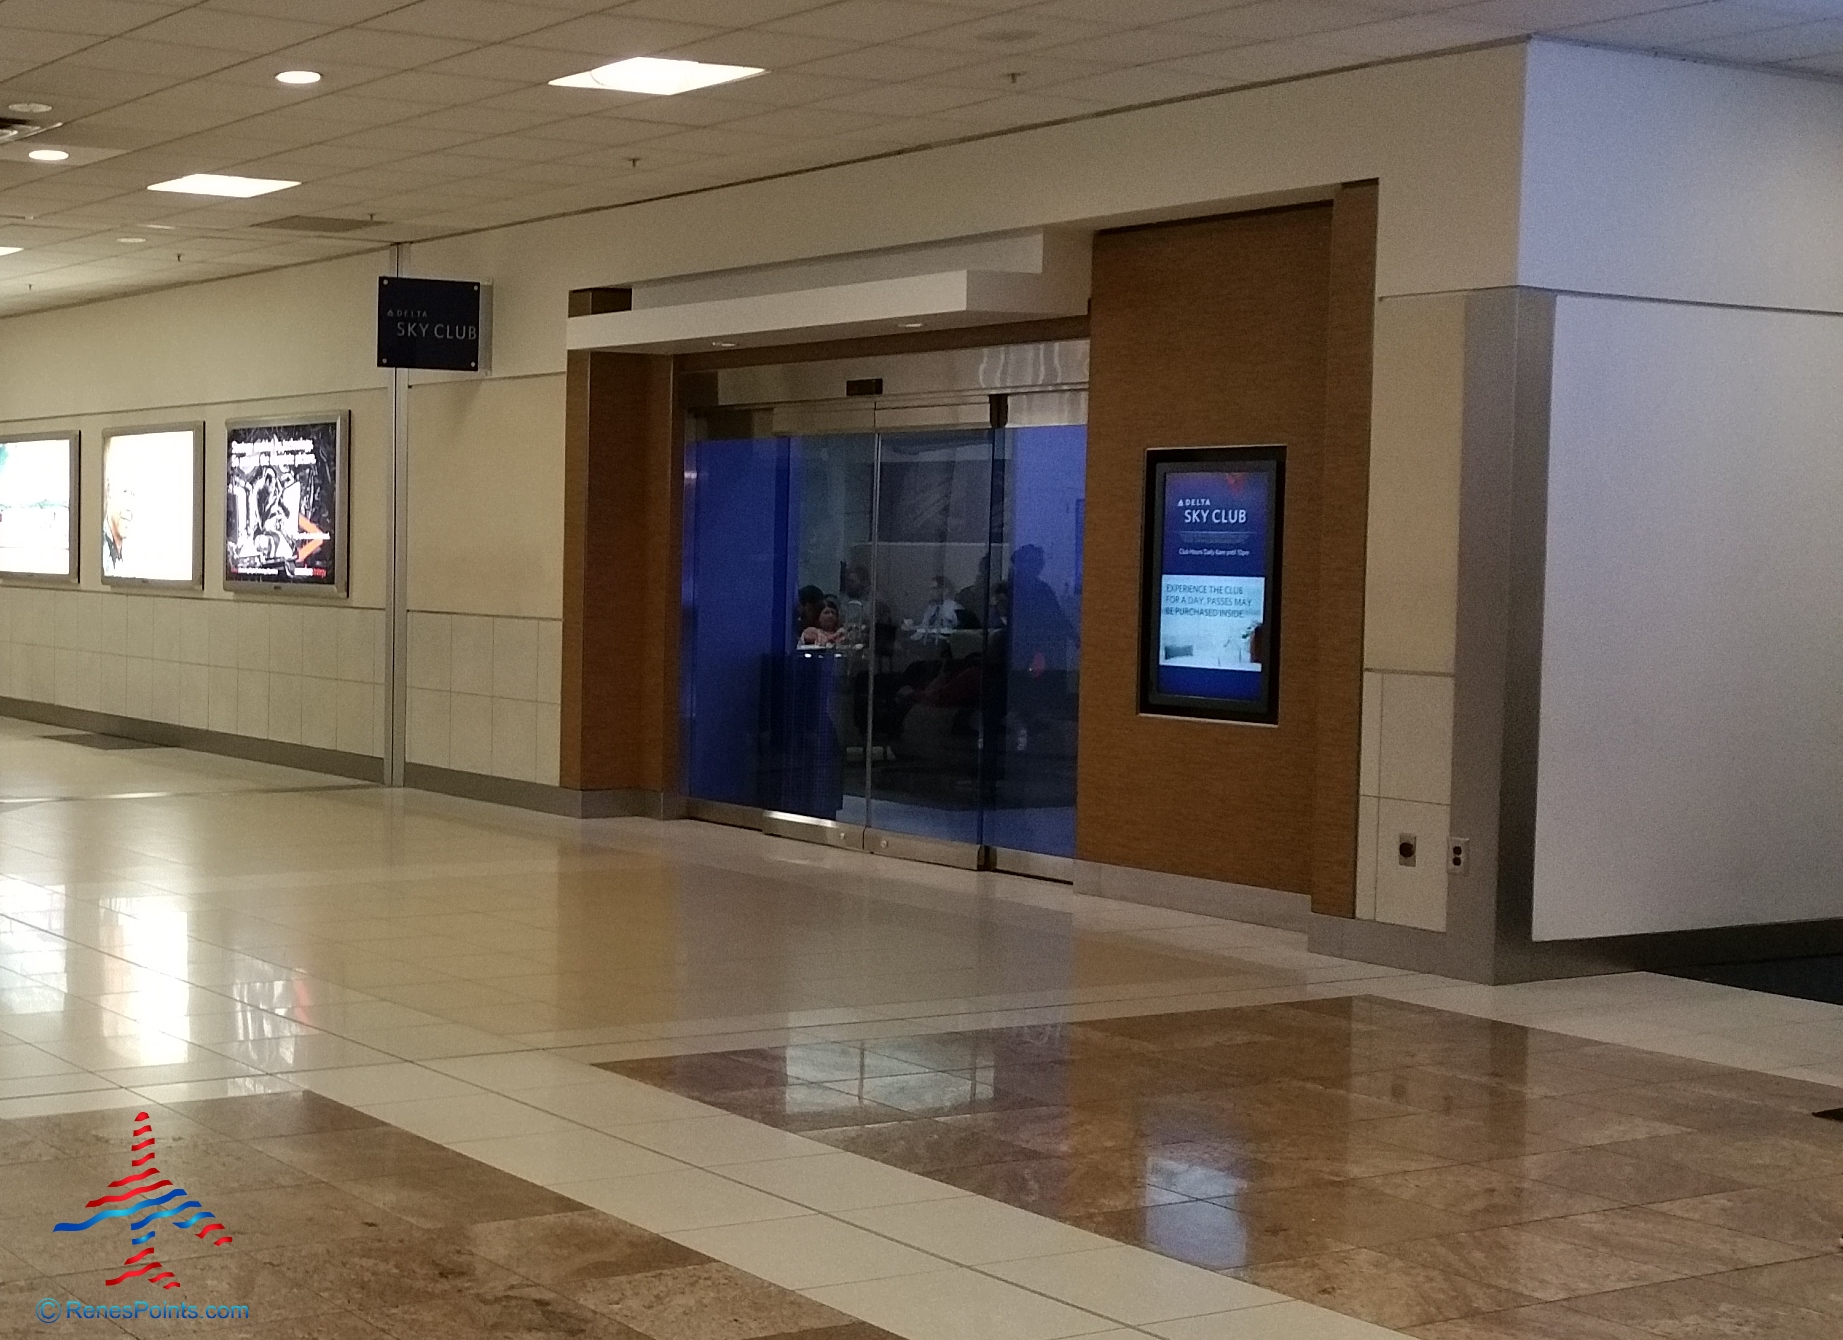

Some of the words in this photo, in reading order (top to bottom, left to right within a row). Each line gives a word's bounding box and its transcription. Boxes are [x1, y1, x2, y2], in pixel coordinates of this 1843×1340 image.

[396, 310, 428, 318] DELTA
[397, 322, 429, 337] SKY
[433, 323, 477, 339] CLUB
[1185, 498, 1211, 506] DELTA
[1184, 509, 1210, 523] SKY
[1211, 509, 1247, 523] CLUB
[1166, 583, 1207, 594] EXPERIENCE
[1209, 585, 1223, 594] THE
[1224, 585, 1244, 595] CLUB
[1166, 595, 1179, 604] FOR
[1181, 596, 1186, 604] A
[1207, 597, 1232, 606] PASSES
[1234, 598, 1252, 606] MAY
[1165, 607, 1174, 615] BE
[1175, 607, 1218, 617] PURCHASED
